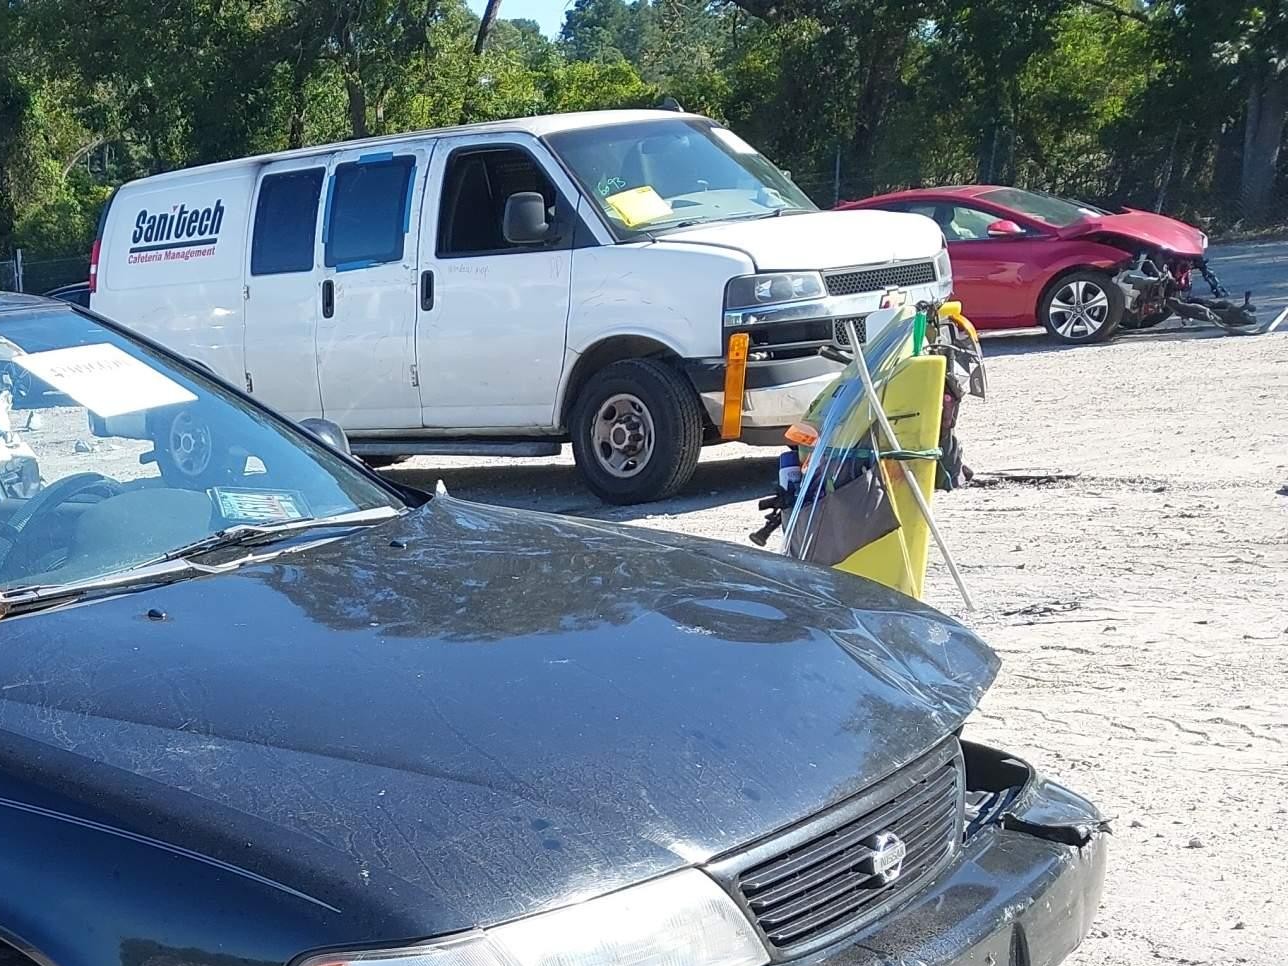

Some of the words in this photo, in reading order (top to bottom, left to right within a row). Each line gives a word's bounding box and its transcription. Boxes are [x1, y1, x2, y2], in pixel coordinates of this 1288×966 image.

[597, 177, 626, 195] 693
[132, 199, 224, 243] Sanitech
[128, 253, 162, 264] Cafeteria
[164, 247, 216, 260] Management
